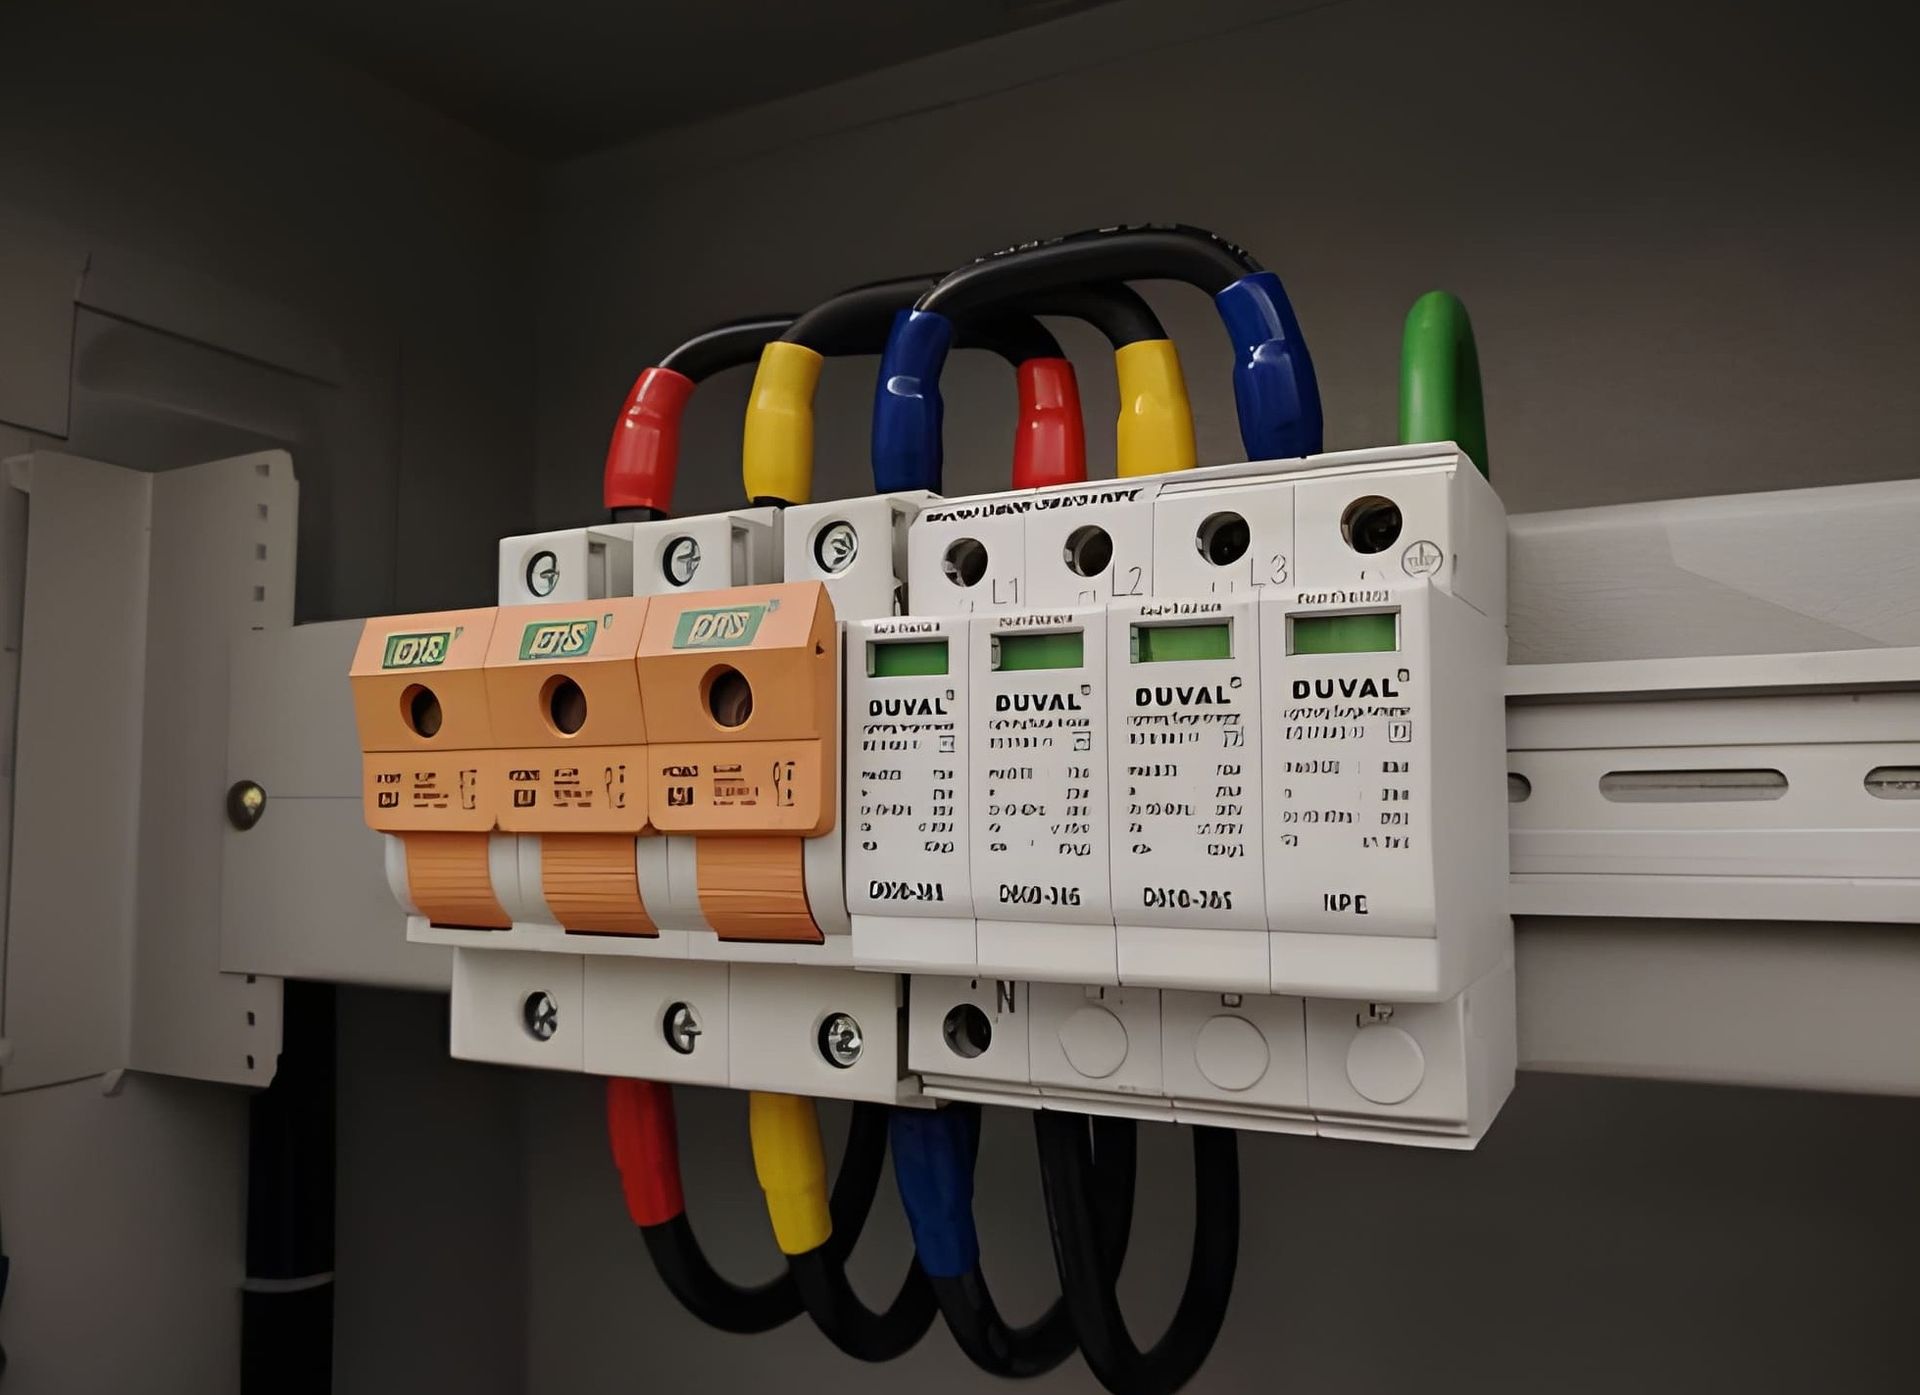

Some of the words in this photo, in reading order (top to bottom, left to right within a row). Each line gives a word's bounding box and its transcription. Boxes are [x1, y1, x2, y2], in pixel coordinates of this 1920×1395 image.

[1111, 560, 1144, 597] L2
[1251, 553, 1288, 588] L3
[993, 577, 1018, 605] L1
[1135, 685, 1231, 707] DUVAL
[1292, 678, 1399, 700] DUVAL
[869, 697, 948, 717] DUVAL
[995, 693, 1082, 712] DUVAL
